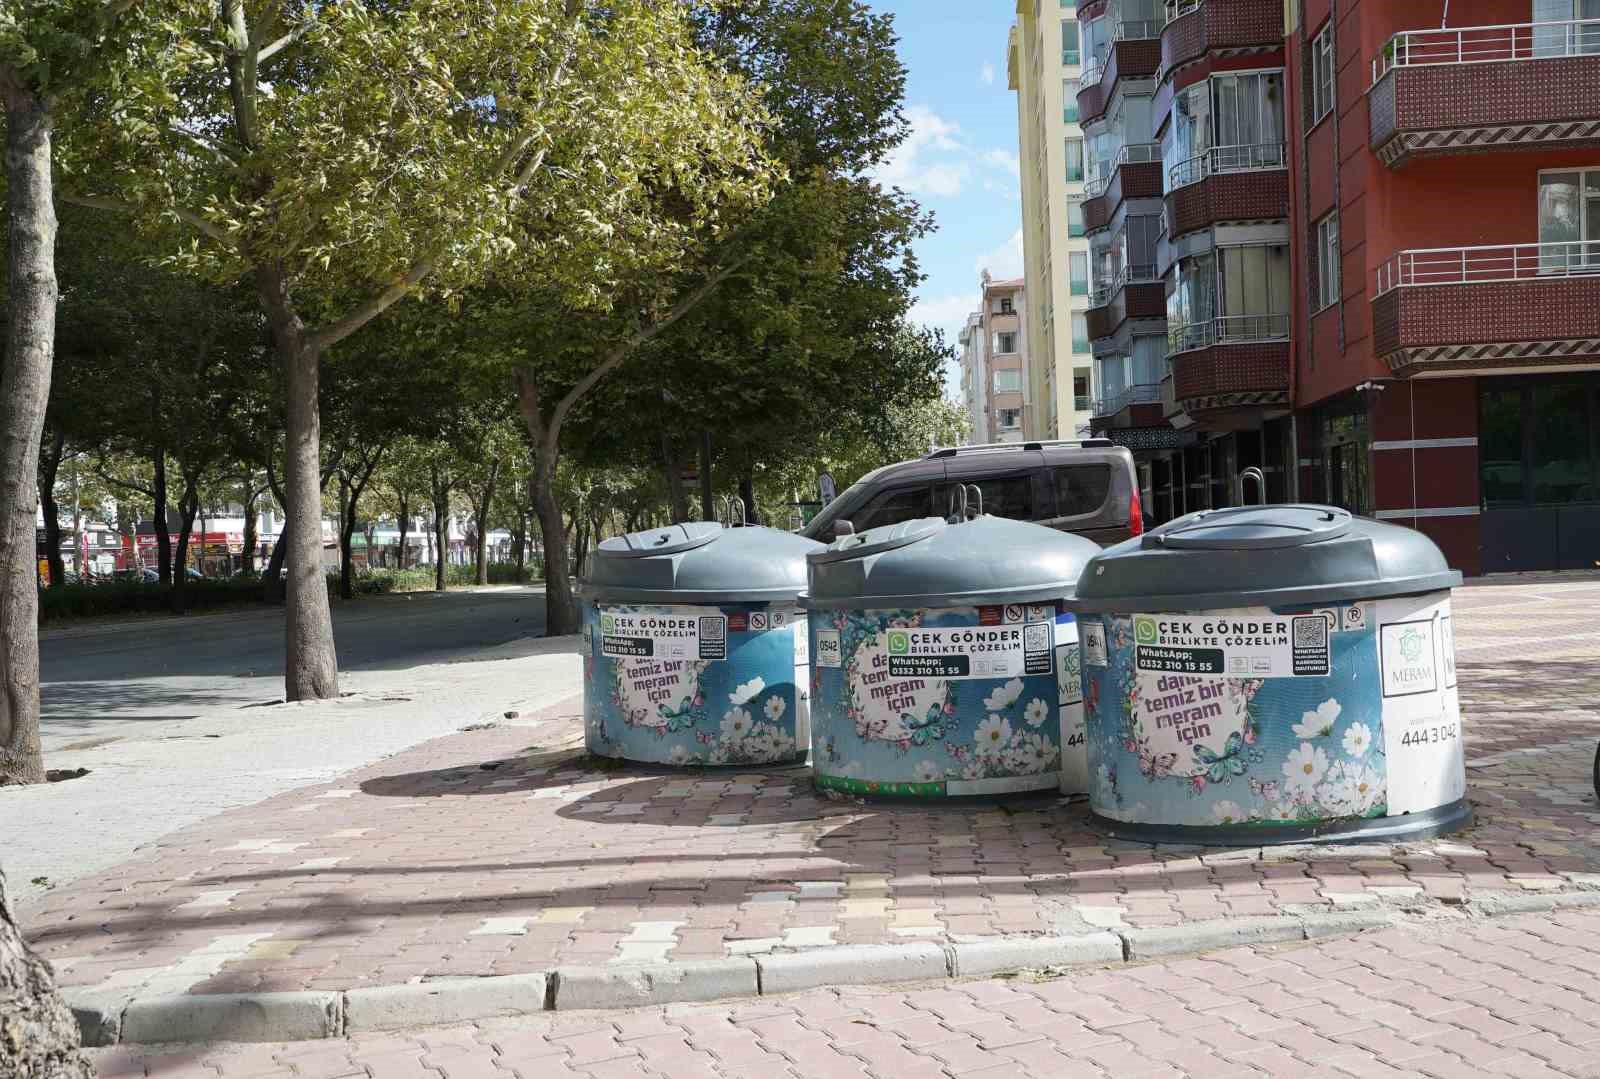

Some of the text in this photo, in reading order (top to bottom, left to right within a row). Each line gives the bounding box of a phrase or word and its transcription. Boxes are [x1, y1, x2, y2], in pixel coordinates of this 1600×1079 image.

[640, 616, 696, 629] GÖNDER
[1159, 620, 1287, 634] ÇEK GÖNDER
[820, 639, 838, 651] 0542
[911, 630, 1020, 645] ÇEK GÖNDER
[872, 653, 887, 668] da
[1140, 660, 1212, 671] 0332 310 15 55
[627, 662, 662, 679] temiz
[861, 670, 888, 685] tem
[918, 667, 933, 675] 310
[935, 667, 945, 675] 15
[948, 666, 960, 674] 55
[634, 674, 680, 691] meram
[870, 680, 926, 699] meram
[648, 687, 671, 704] için
[887, 693, 916, 714] için
[1145, 680, 1224, 713] temiz bir
[1156, 702, 1222, 729] meram
[1176, 721, 1211, 746] için
[1402, 728, 1429, 747] 444
[1431, 727, 1438, 743] 3
